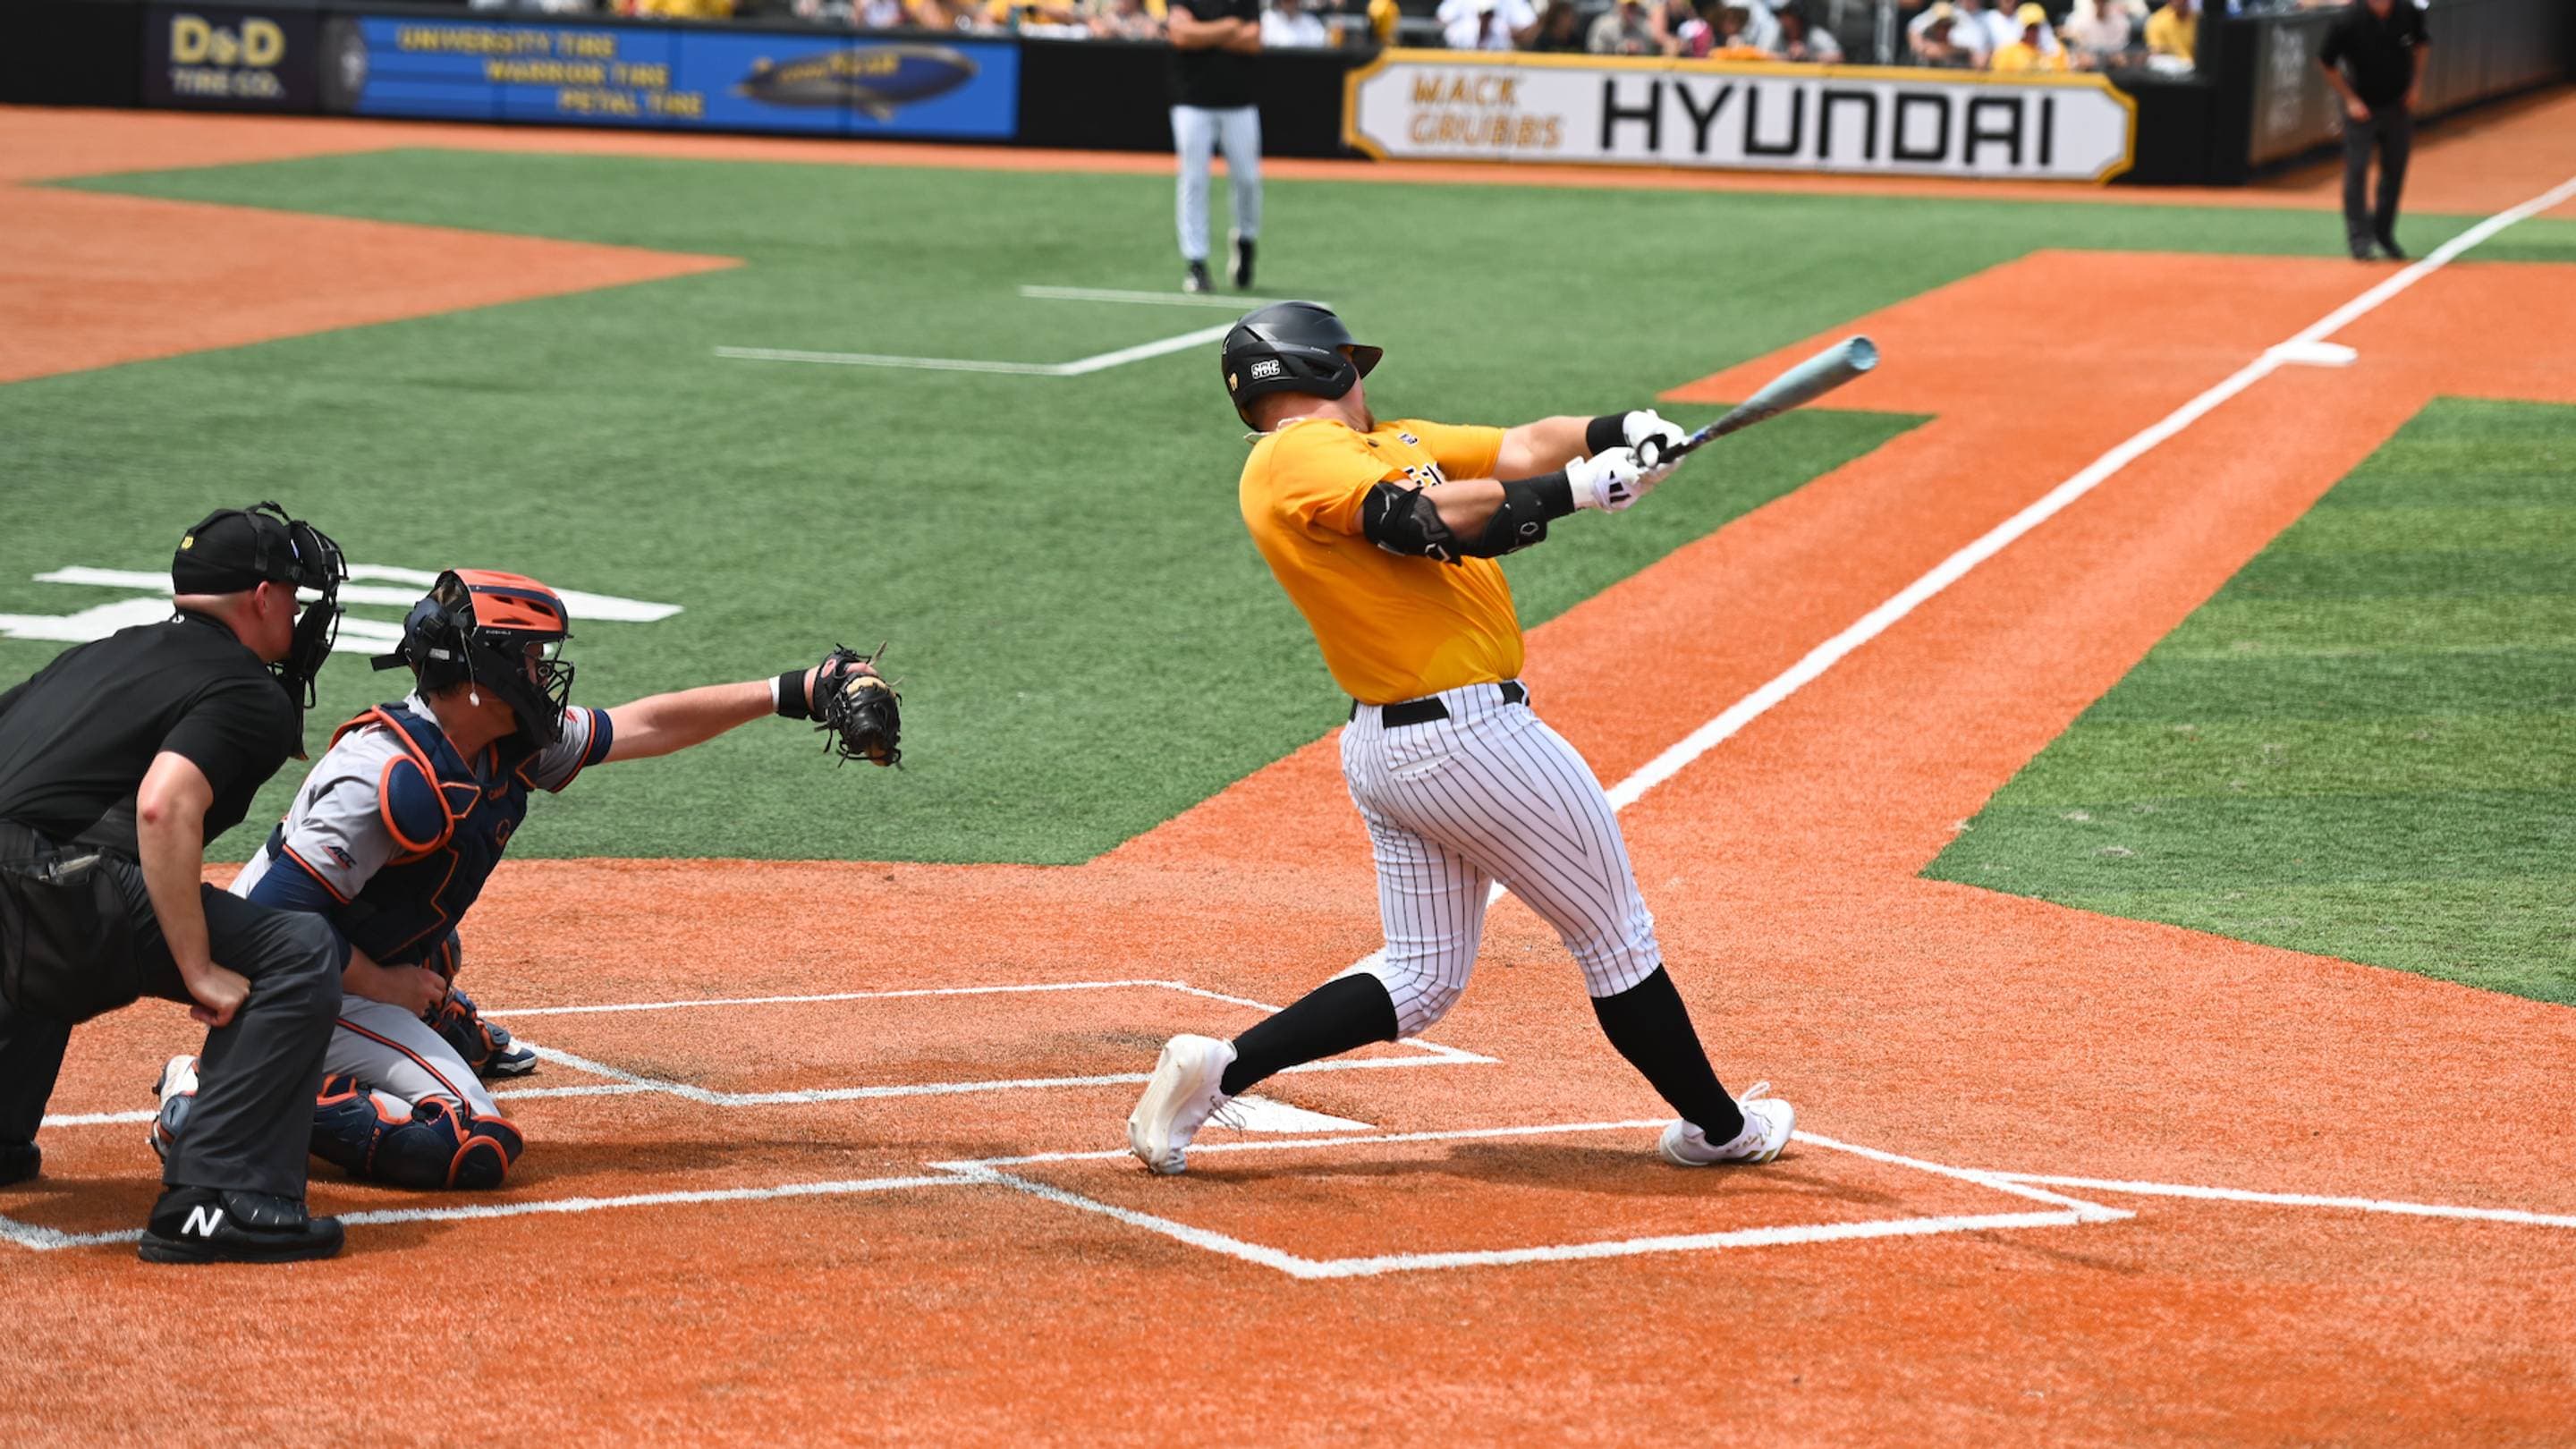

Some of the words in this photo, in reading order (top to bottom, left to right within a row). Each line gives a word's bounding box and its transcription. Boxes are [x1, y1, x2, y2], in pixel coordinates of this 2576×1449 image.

[171, 14, 285, 66] D&D
[397, 25, 550, 55] UNIVERSITY
[555, 30, 617, 58] TIRE
[169, 68, 229, 96] TIRE
[484, 58, 606, 85] WARRIOR
[611, 62, 668, 88] TIRE
[1411, 73, 1519, 106] MACK
[558, 88, 639, 116] PETAL
[645, 91, 703, 118] TIRE
[1411, 112, 1562, 148] GRUBBS
[1601, 78, 2055, 167] HYUNDAI
[181, 1205, 224, 1237] N
